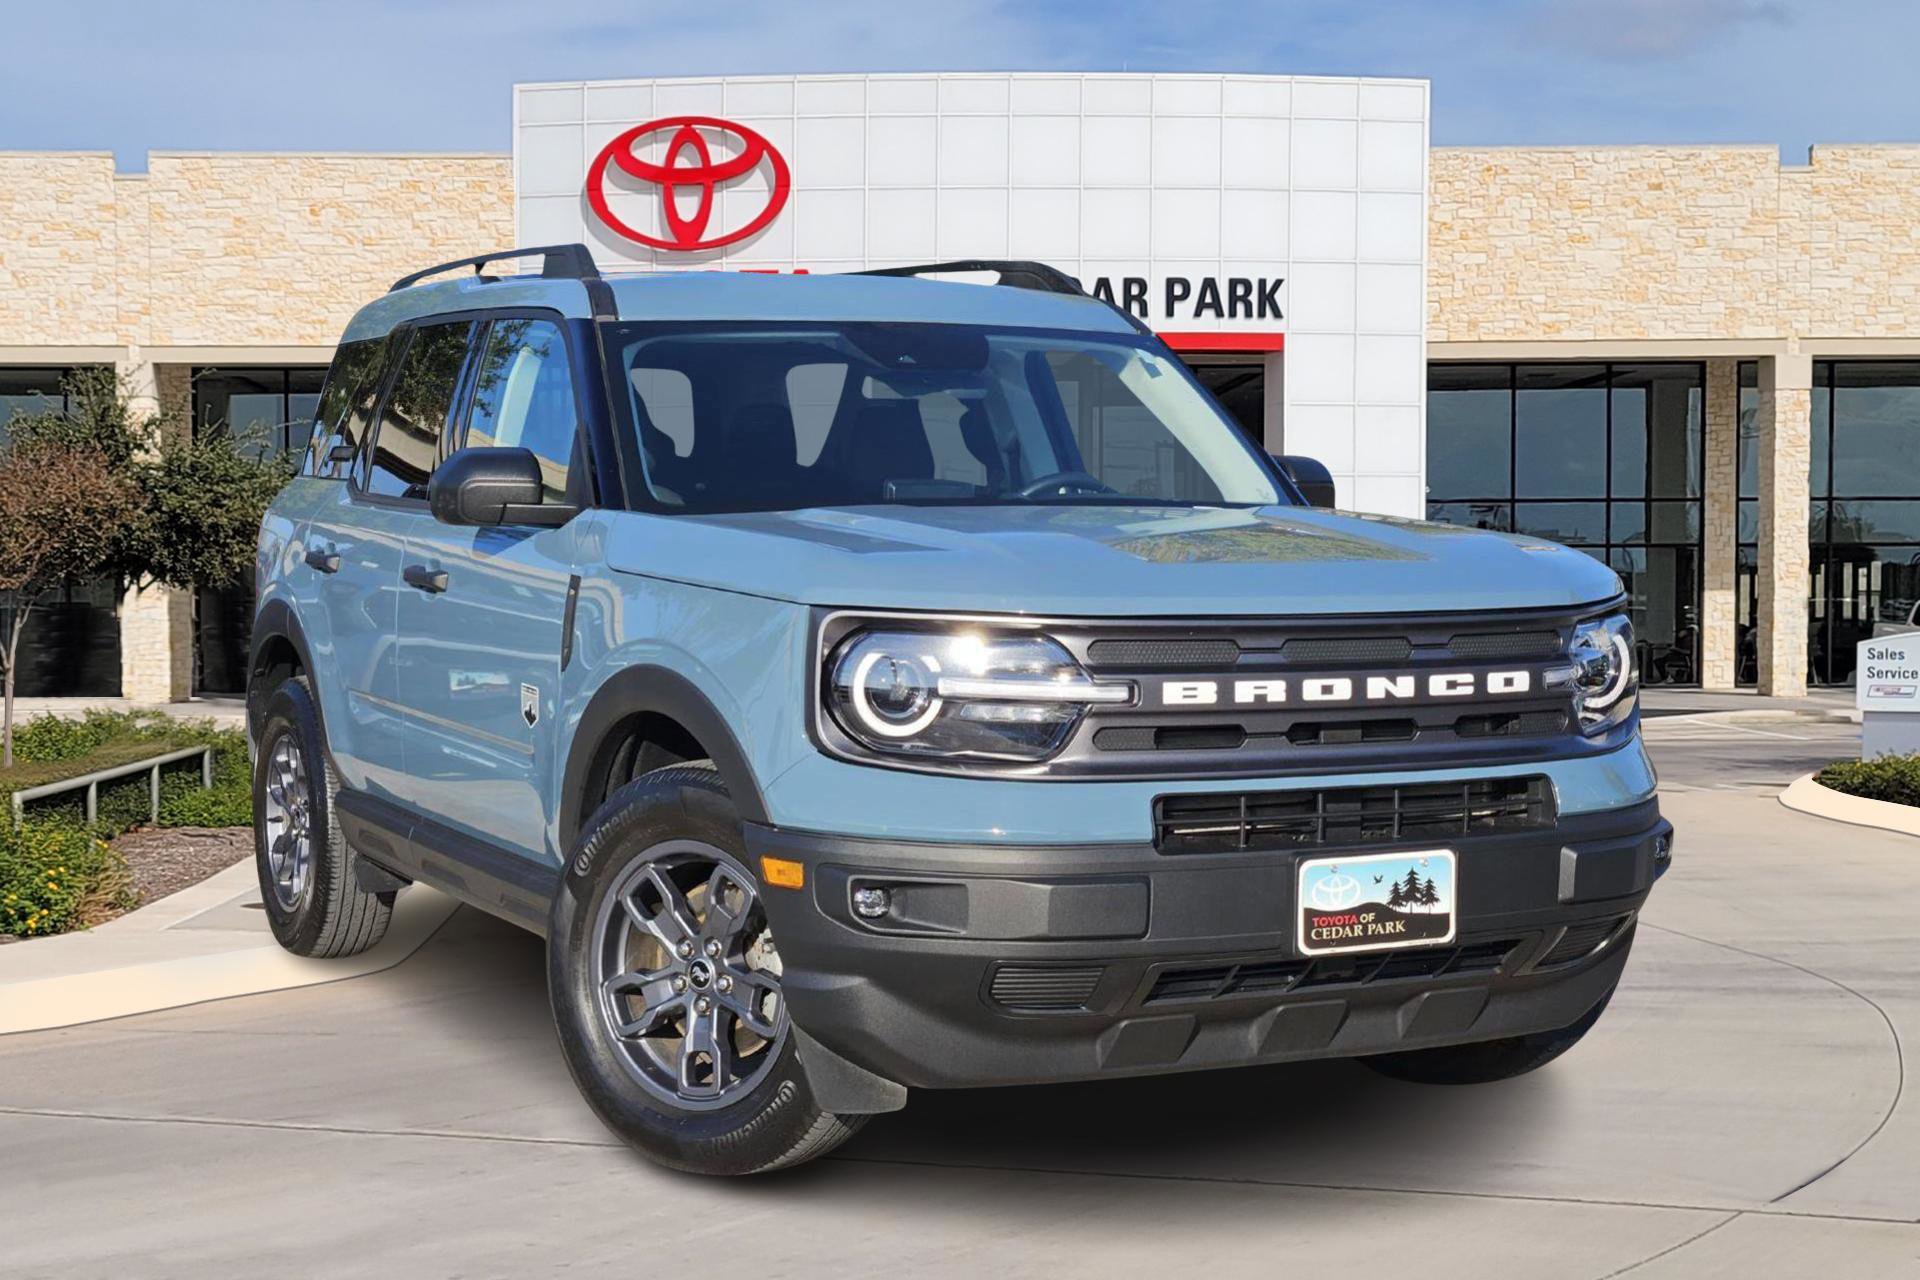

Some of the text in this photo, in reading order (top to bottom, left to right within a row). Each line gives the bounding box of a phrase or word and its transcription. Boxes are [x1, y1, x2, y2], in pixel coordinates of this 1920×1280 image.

[1072, 277, 1285, 319] AR PARK
[1867, 647, 1905, 661] Sales
[1867, 666, 1918, 680] Service
[1162, 671, 1530, 705] BRONCO
[1311, 912, 1376, 927] TOYOTA OF
[1311, 920, 1406, 940] CEDAR PARK
